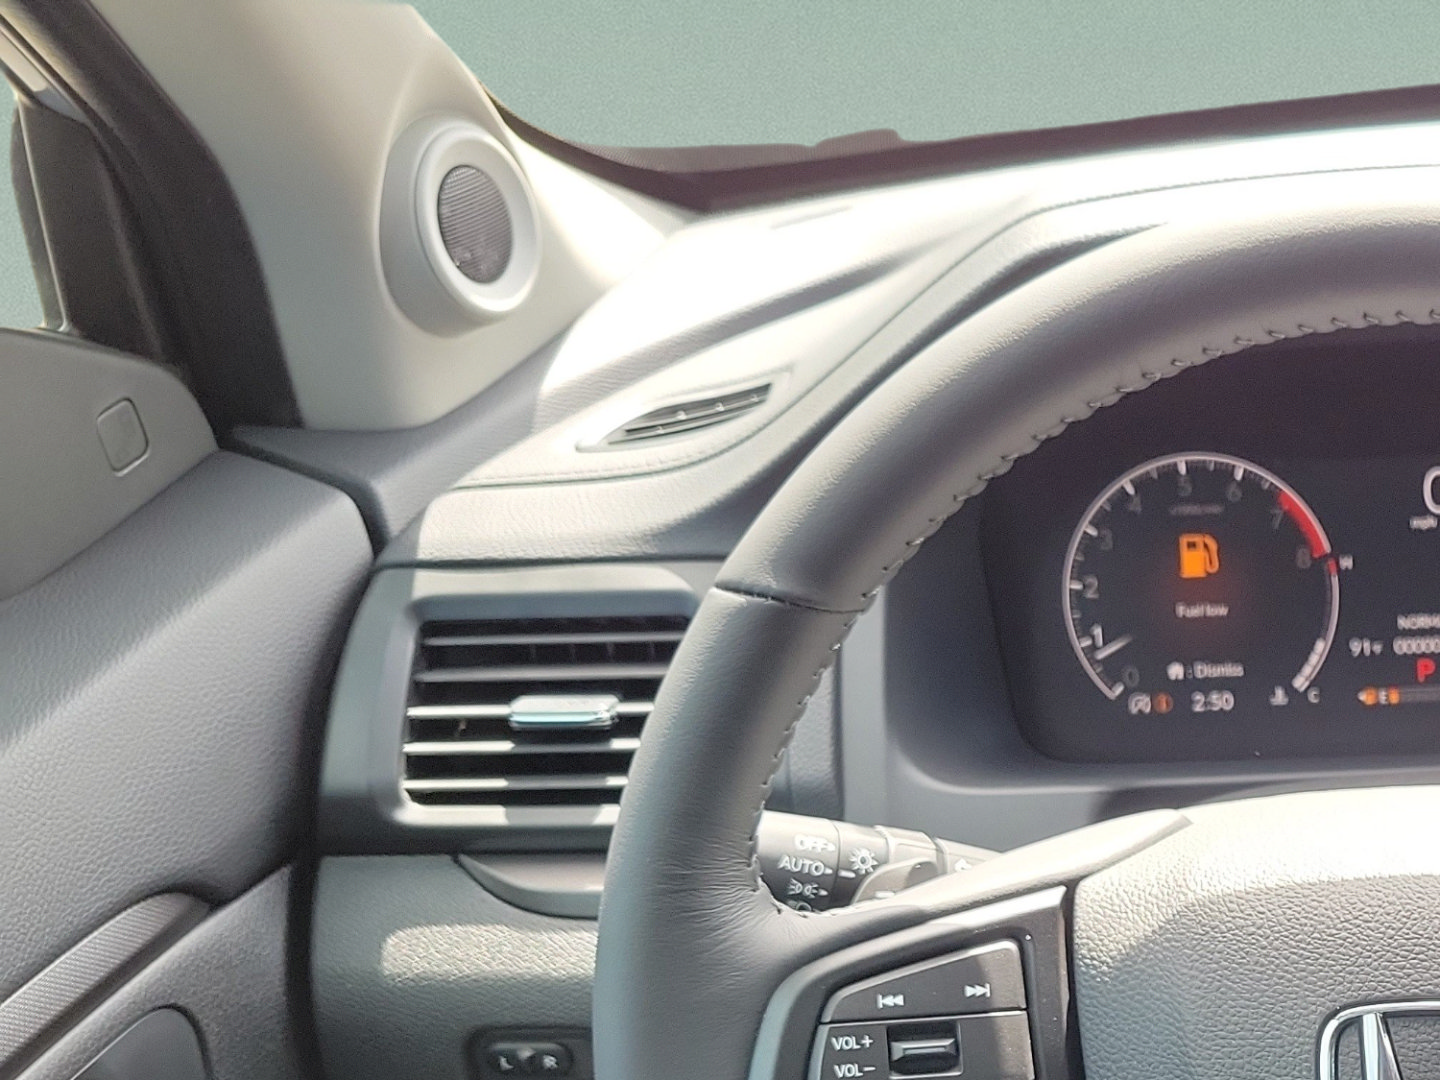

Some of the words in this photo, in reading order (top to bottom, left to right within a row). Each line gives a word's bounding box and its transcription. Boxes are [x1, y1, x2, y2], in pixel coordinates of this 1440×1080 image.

[1178, 473, 1193, 497] 5
[1226, 479, 1242, 501] 6
[1083, 575, 1099, 599] 2
[1091, 623, 1103, 648] 1
[1416, 657, 1436, 683] P
[1191, 689, 1234, 712] 2:50
[778, 854, 825, 876] AUTO
[831, 1034, 874, 1051] VOL+
